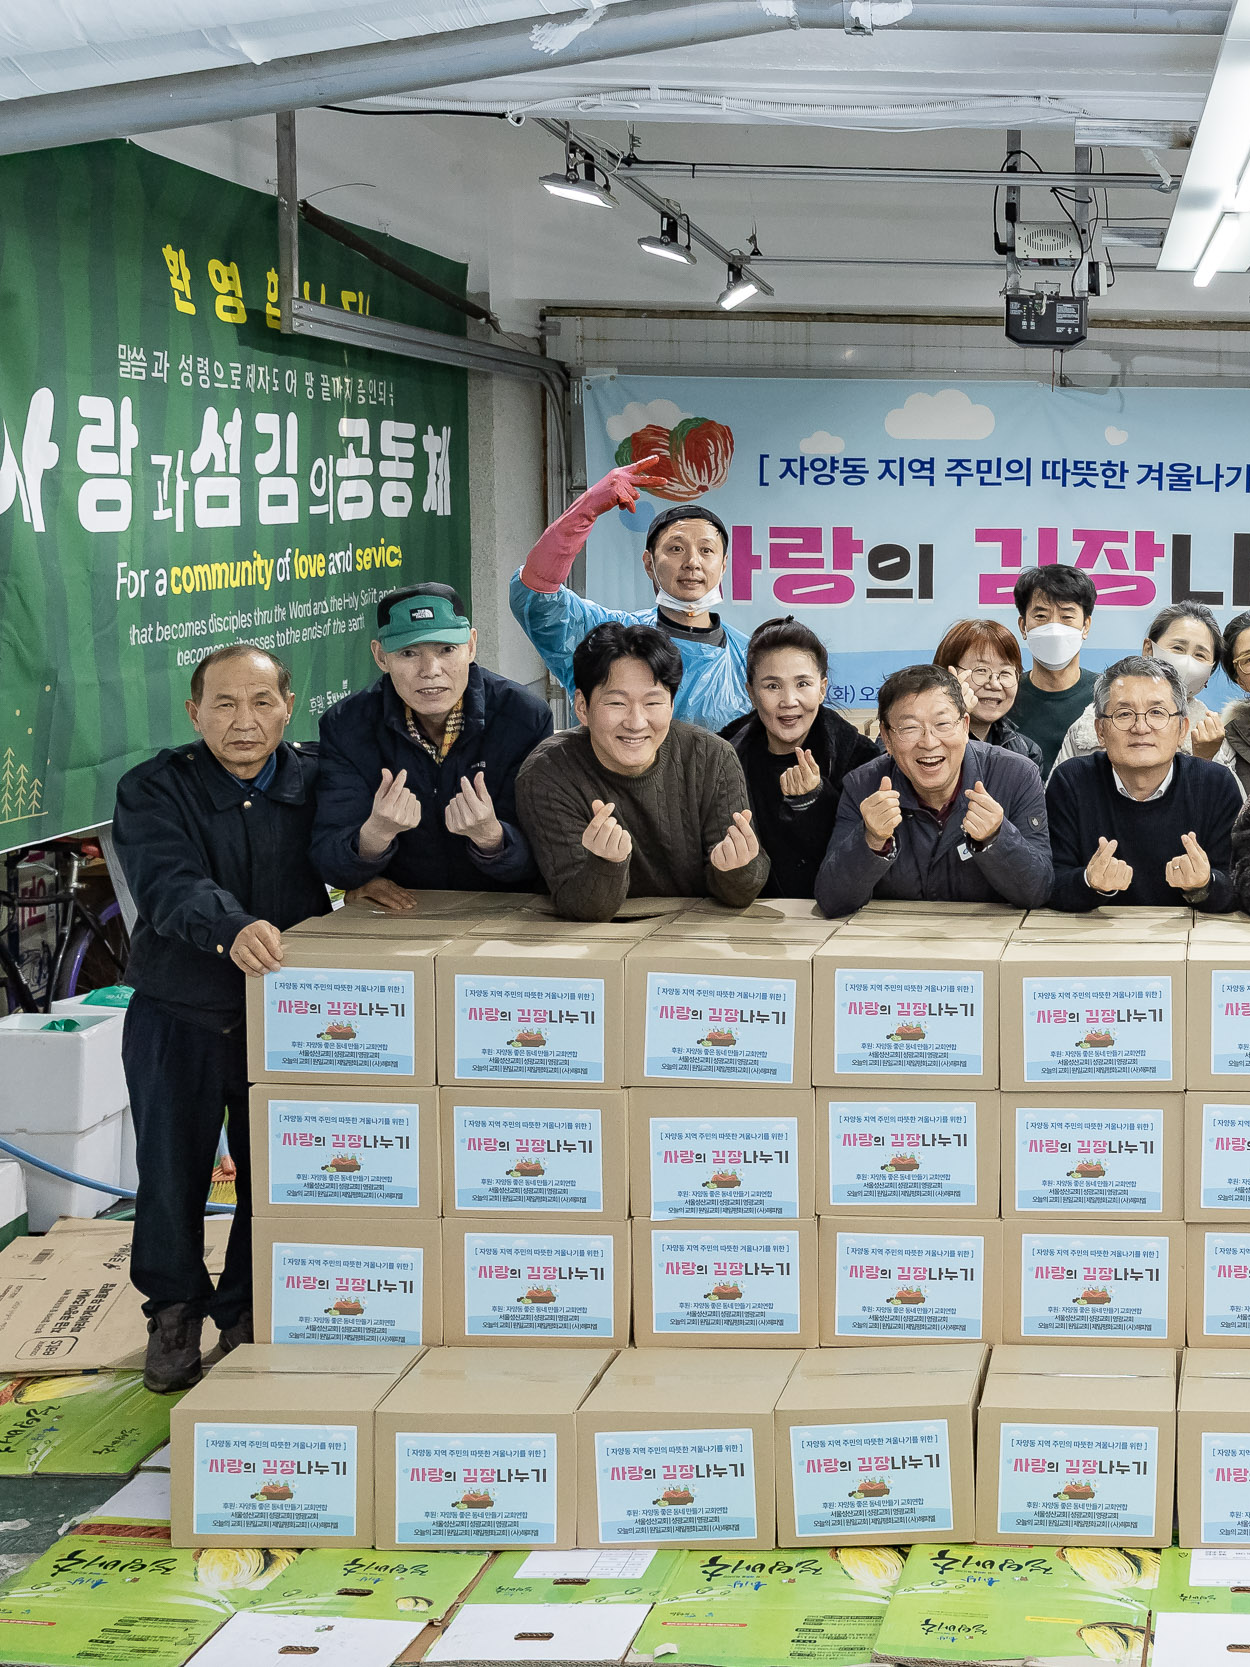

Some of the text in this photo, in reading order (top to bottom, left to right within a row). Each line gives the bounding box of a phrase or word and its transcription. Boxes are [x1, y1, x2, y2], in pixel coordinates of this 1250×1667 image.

[778, 455, 869, 486] 자양동
[877, 456, 935, 487] 지역
[944, 456, 1032, 487] 주민의
[1042, 458, 1129, 489] 따뜻한
[116, 562, 150, 600] For
[155, 568, 168, 597] a
[170, 550, 274, 595] community
[276, 548, 292, 582] of
[294, 548, 326, 579] love
[328, 543, 353, 576] and
[129, 623, 153, 646] that
[156, 620, 207, 642] becomes
[208, 610, 252, 634] disciples
[254, 607, 273, 626] thru
[274, 604, 286, 622] the
[289, 599, 312, 619] Word
[329, 597, 343, 612] the
[286, 626, 300, 645] the
[332, 616, 346, 635] the
[826, 685, 879, 703] (화) 오
[278, 1000, 404, 1017] 사랑의 김장나누기
[659, 1005, 785, 1025] 사랑의 김장나누기
[848, 1002, 973, 1017] 사랑의 김장나누기
[282, 1132, 409, 1149] 사랑의 김장나누기
[1029, 1140, 1153, 1154] 사랑의 김장나누기
[664, 1150, 788, 1164] 사랑의 김장나누기
[478, 1265, 604, 1280] 사랑의 김장나누기
[665, 1262, 789, 1276] 사랑의 김장나누기
[1035, 1266, 1159, 1281] 사랑의 김장나누기
[43, 1340, 62, 1356] eats
[806, 1454, 940, 1474] 사랑의 김장나누기
[410, 1468, 546, 1483] 사랑의 김장나누기
[700, 1555, 822, 1582] 절임배추
[930, 1549, 1053, 1575] 절임배추
